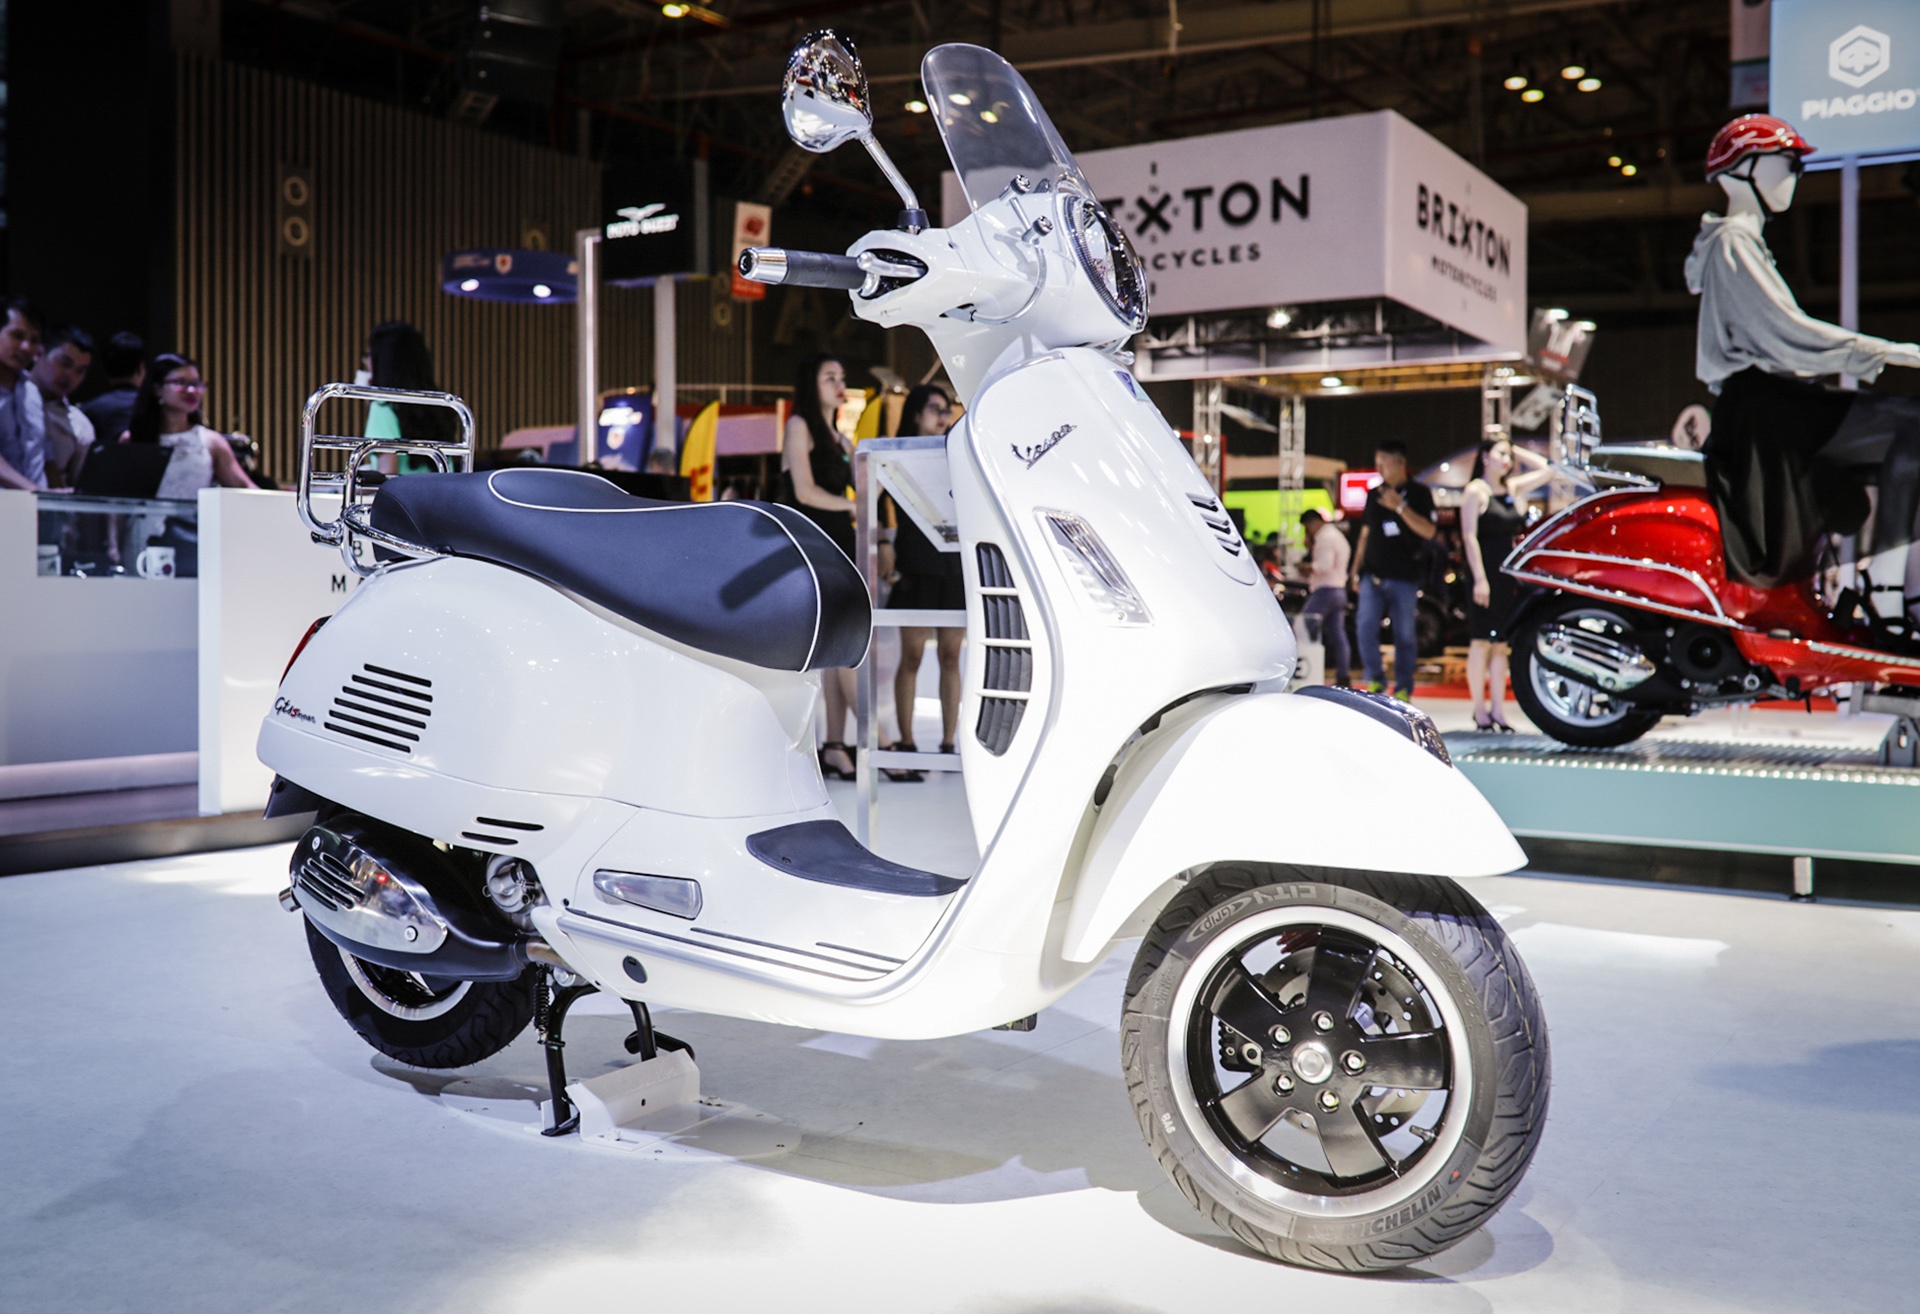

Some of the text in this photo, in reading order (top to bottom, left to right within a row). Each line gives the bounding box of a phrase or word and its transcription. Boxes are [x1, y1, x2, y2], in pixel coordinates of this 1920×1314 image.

[1802, 89, 1916, 121] PIAGGIO
[1417, 183, 1510, 277] BRIXTON
[1252, 885, 1317, 905] CITY
[1346, 1185, 1443, 1239] MICHELIN
